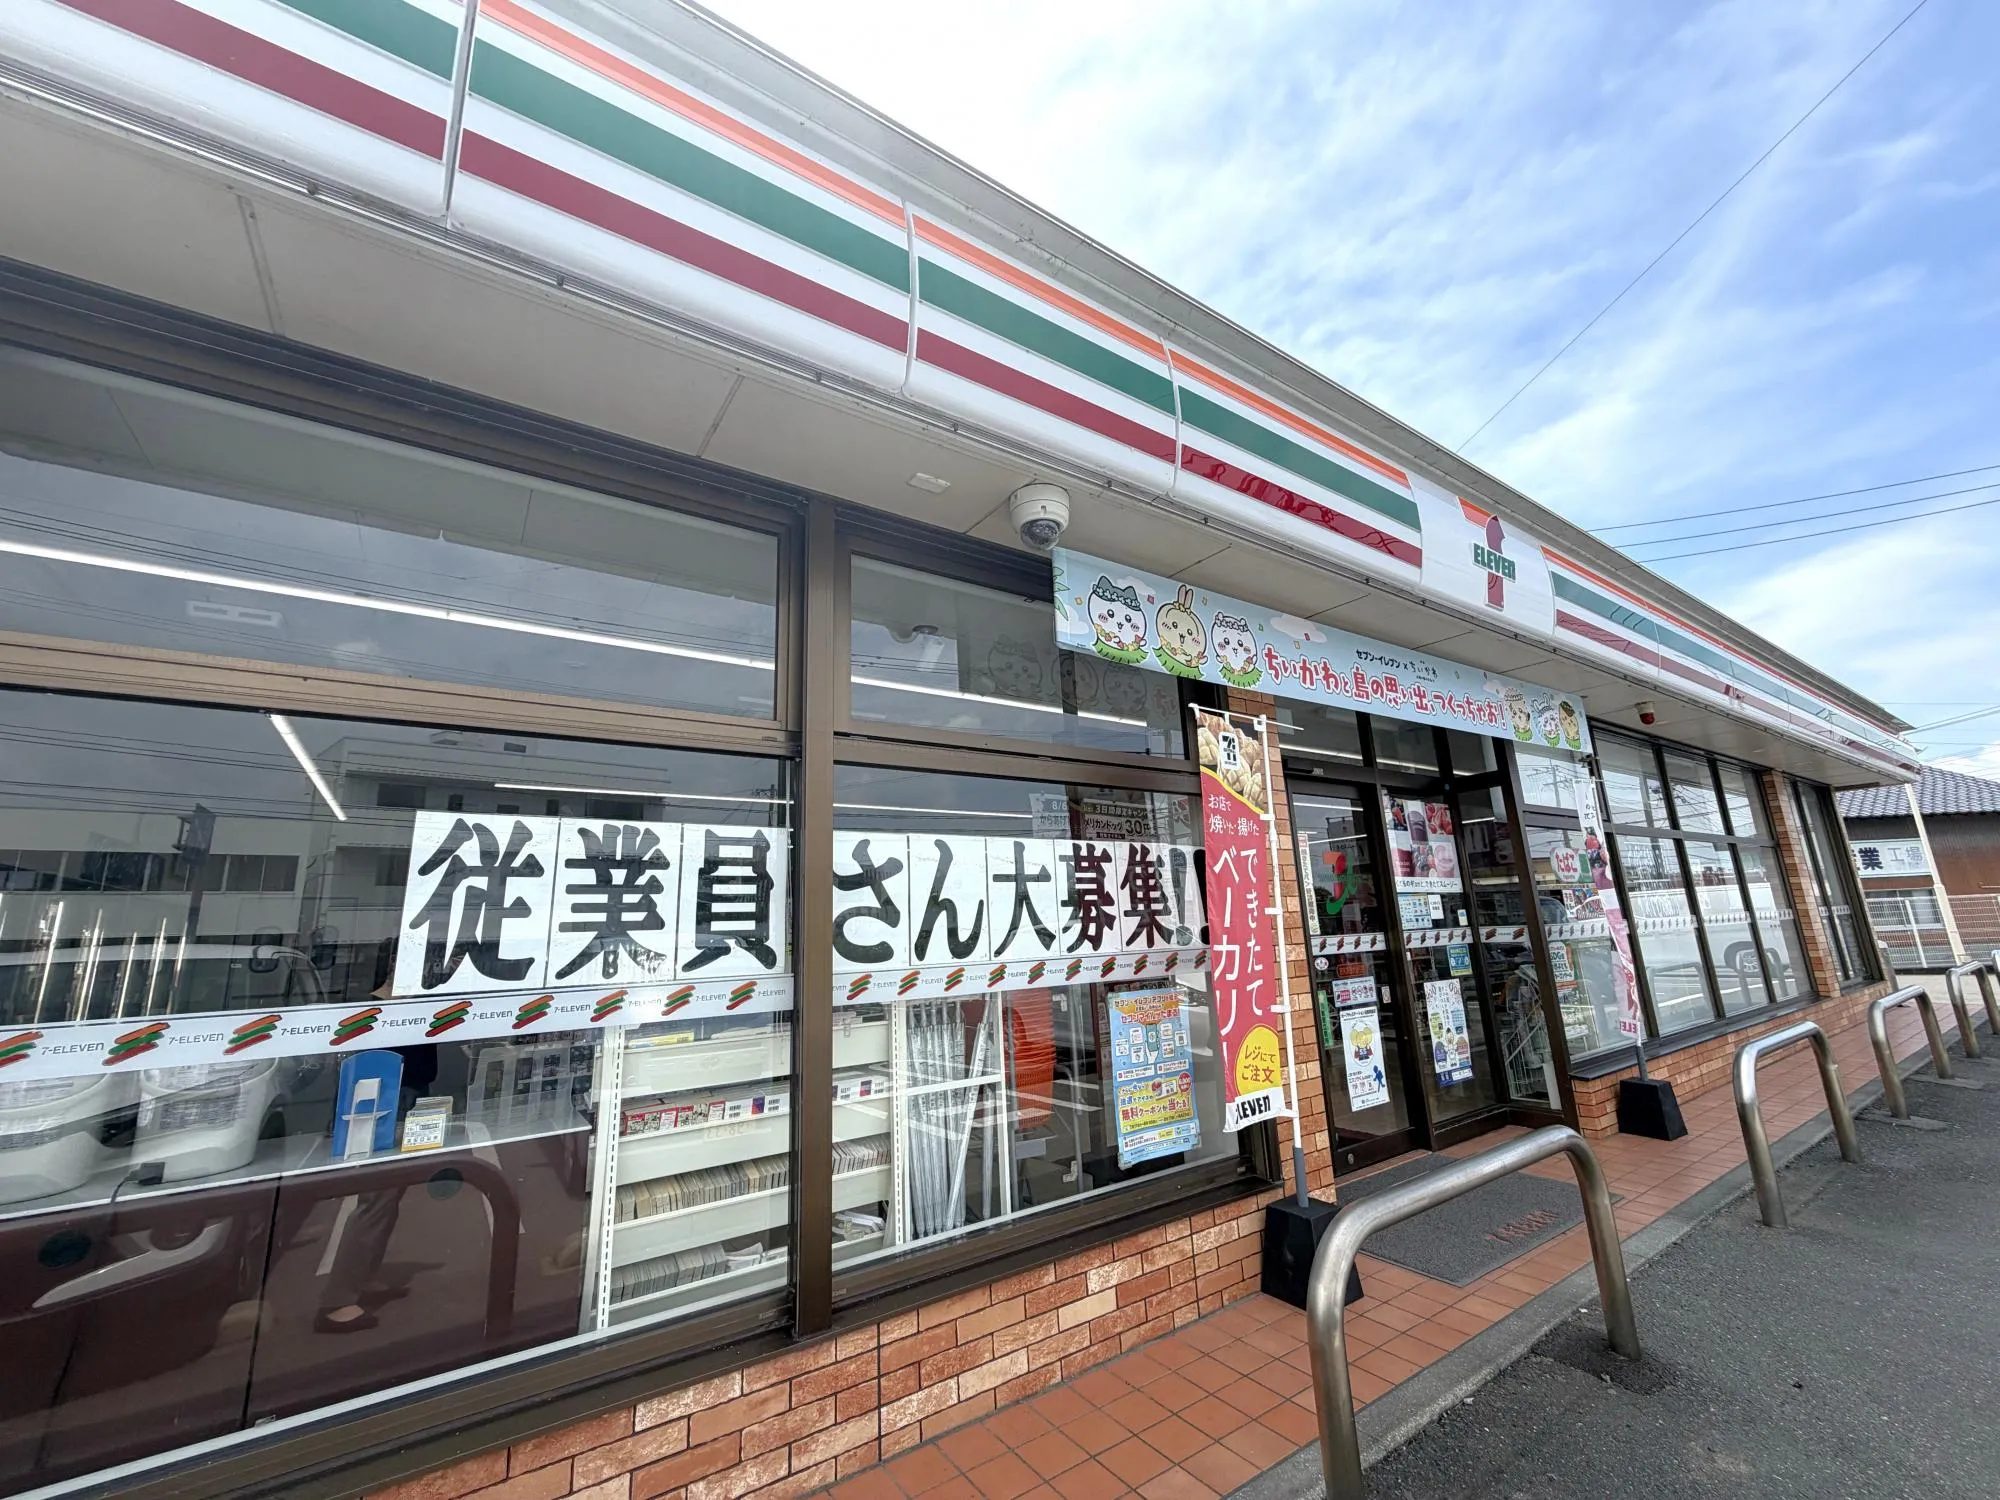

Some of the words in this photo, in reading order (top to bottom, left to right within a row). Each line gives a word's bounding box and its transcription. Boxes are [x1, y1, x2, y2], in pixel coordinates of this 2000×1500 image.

[1208, 793, 1233, 813] お店で
[1555, 851, 1577, 873] たばこ
[409, 817, 778, 990] 従業員
[1240, 847, 1265, 1017] できたて
[1244, 1043, 1277, 1065] レジにて
[1241, 1064, 1275, 1084] ご注文
